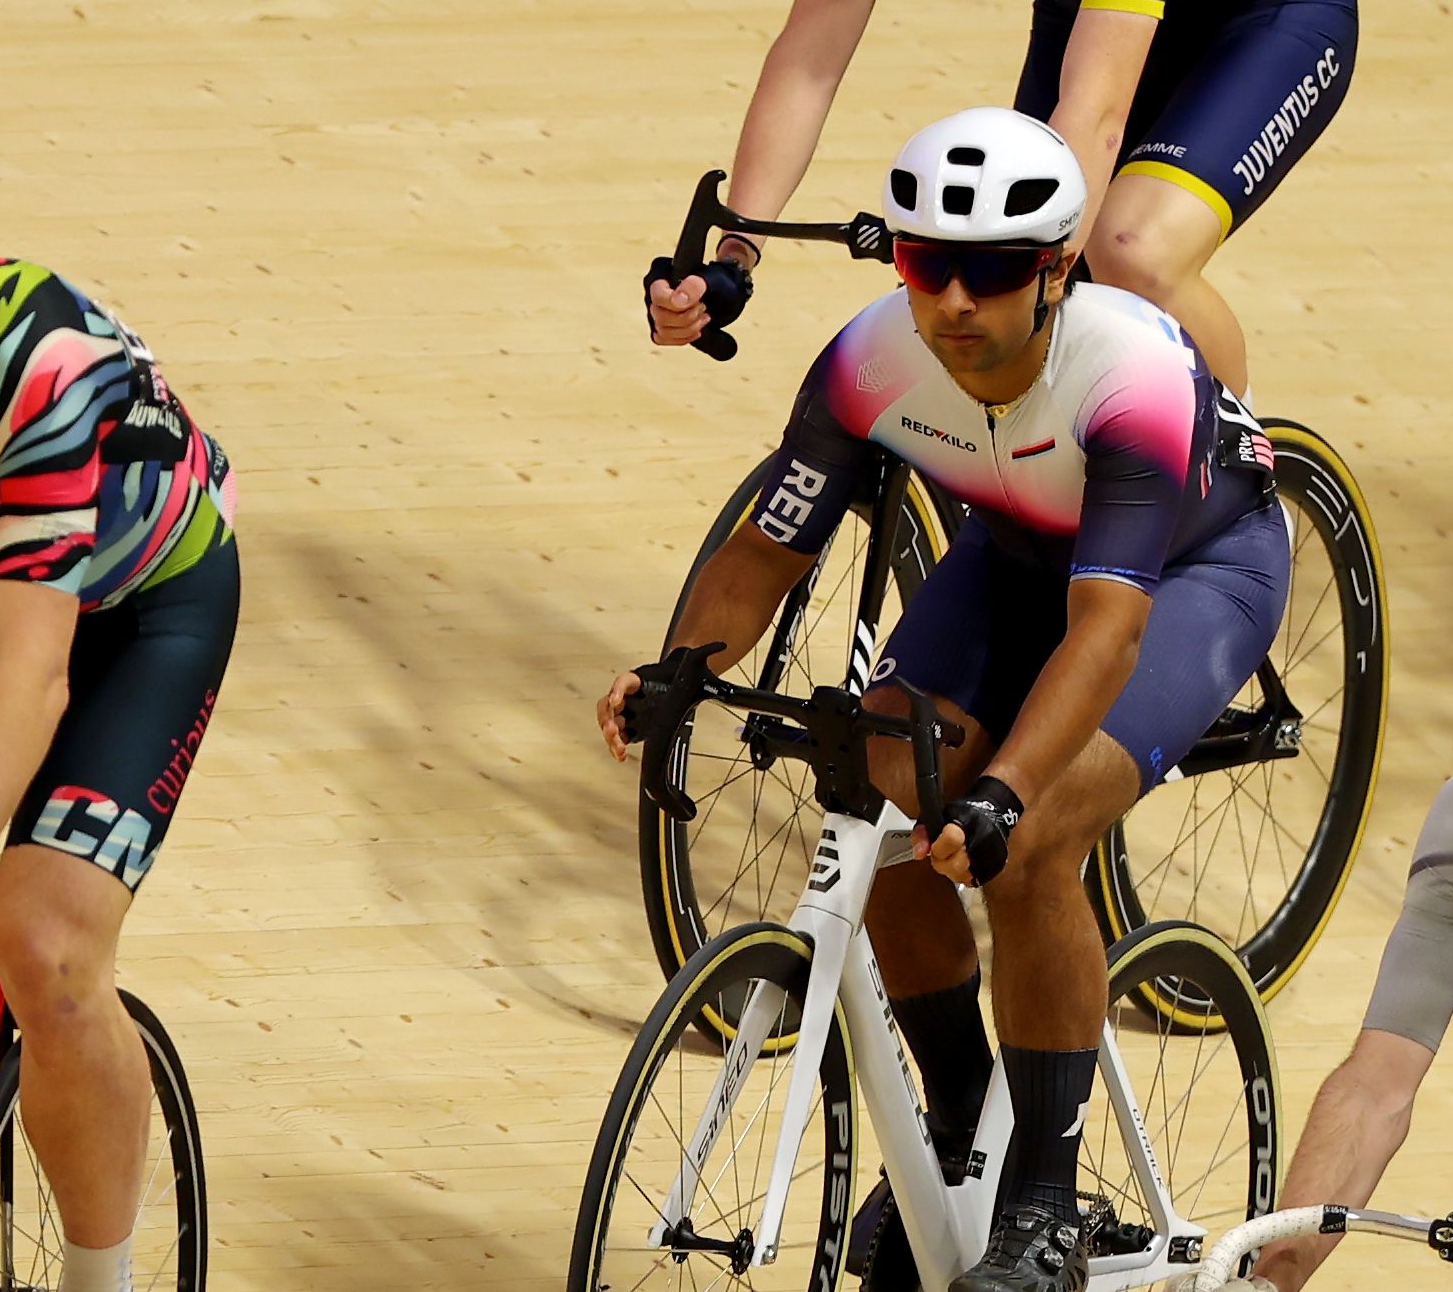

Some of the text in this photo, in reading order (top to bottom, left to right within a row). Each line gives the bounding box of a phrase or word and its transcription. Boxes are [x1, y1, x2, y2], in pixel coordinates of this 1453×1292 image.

[1232, 47, 1342, 196] JUVENTUS CC
[1240, 430, 1256, 462] PRW
[750, 459, 828, 544] RED
[146, 687, 215, 815] curious
